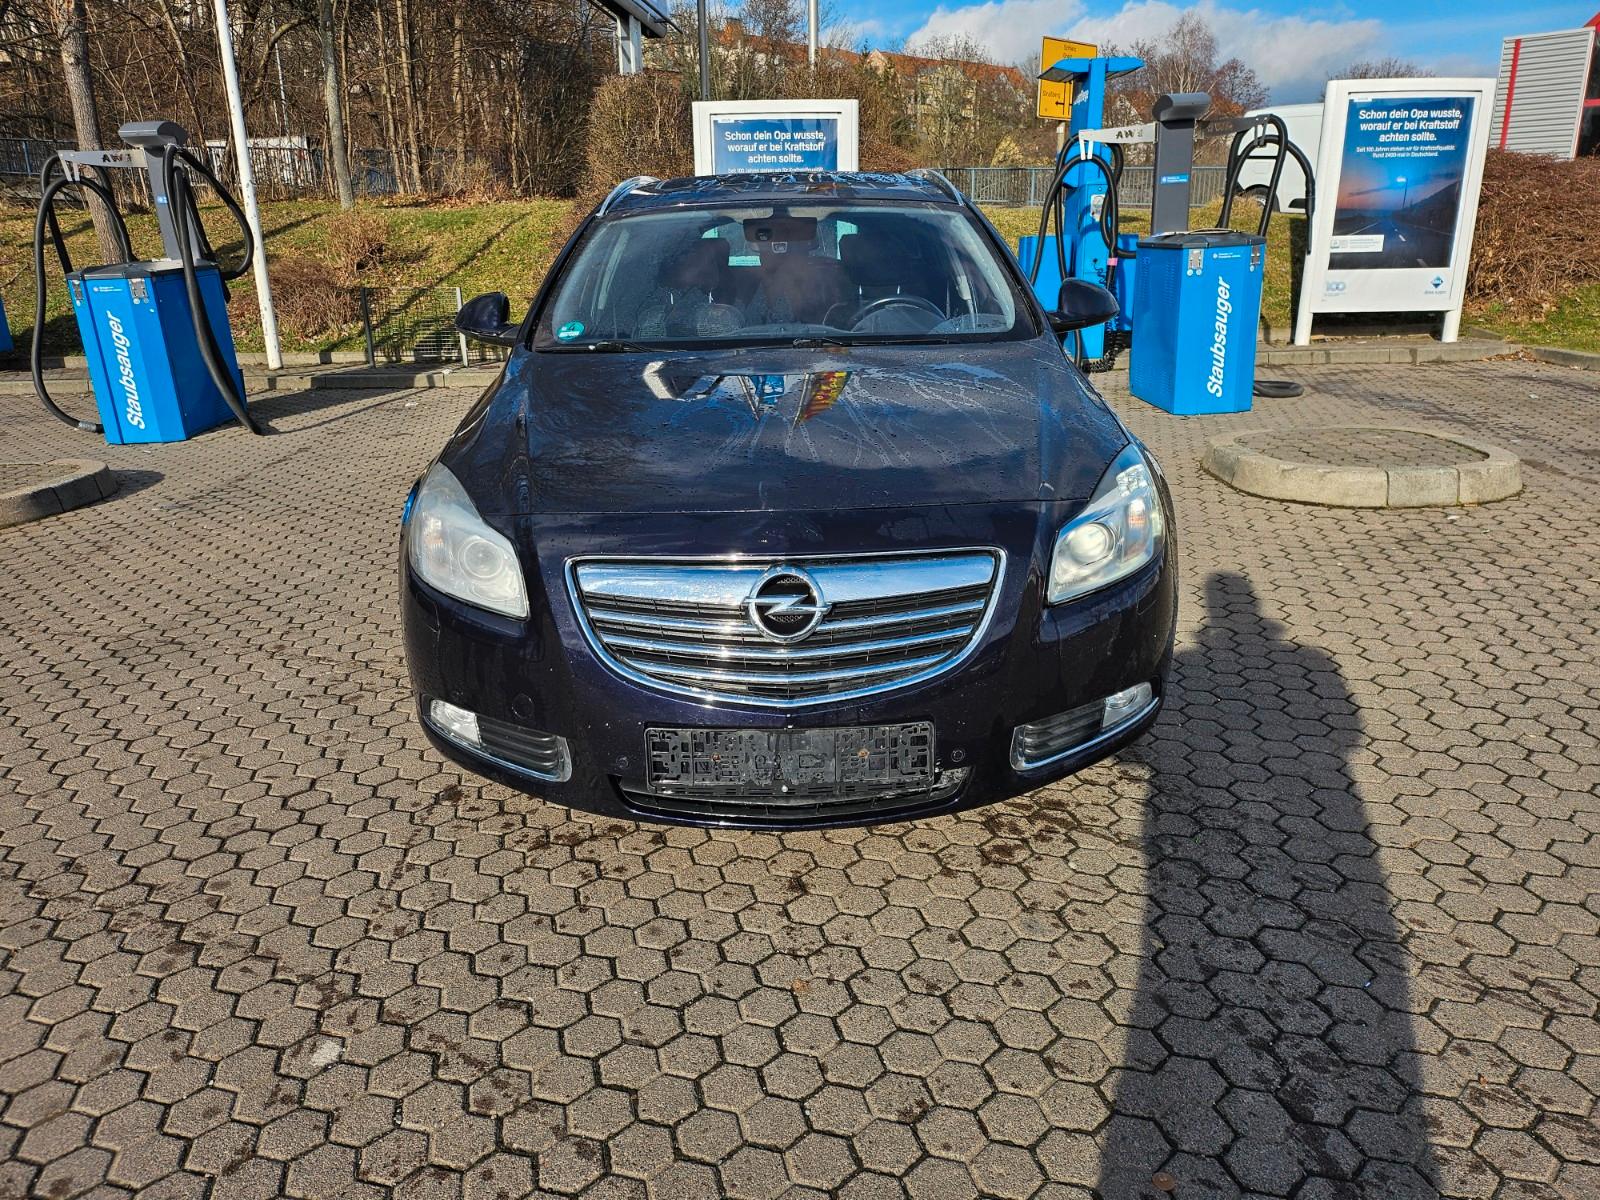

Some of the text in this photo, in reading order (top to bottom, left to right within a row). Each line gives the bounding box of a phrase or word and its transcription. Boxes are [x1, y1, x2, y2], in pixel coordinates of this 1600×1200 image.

[1359, 108, 1462, 119] Schon dein Opa wusste,
[1360, 120, 1459, 130] worauf er bei Kraftstoff
[725, 130, 826, 141] Schon dein Opa wusste,
[1379, 132, 1437, 142] achten sollte.
[728, 143, 757, 152] worauf
[770, 142, 782, 151] bei
[784, 142, 824, 151] Kraftstoff
[748, 154, 804, 163] achten sollte.
[1207, 276, 1233, 398] Staubsauger
[105, 310, 146, 430] Staubsauger
